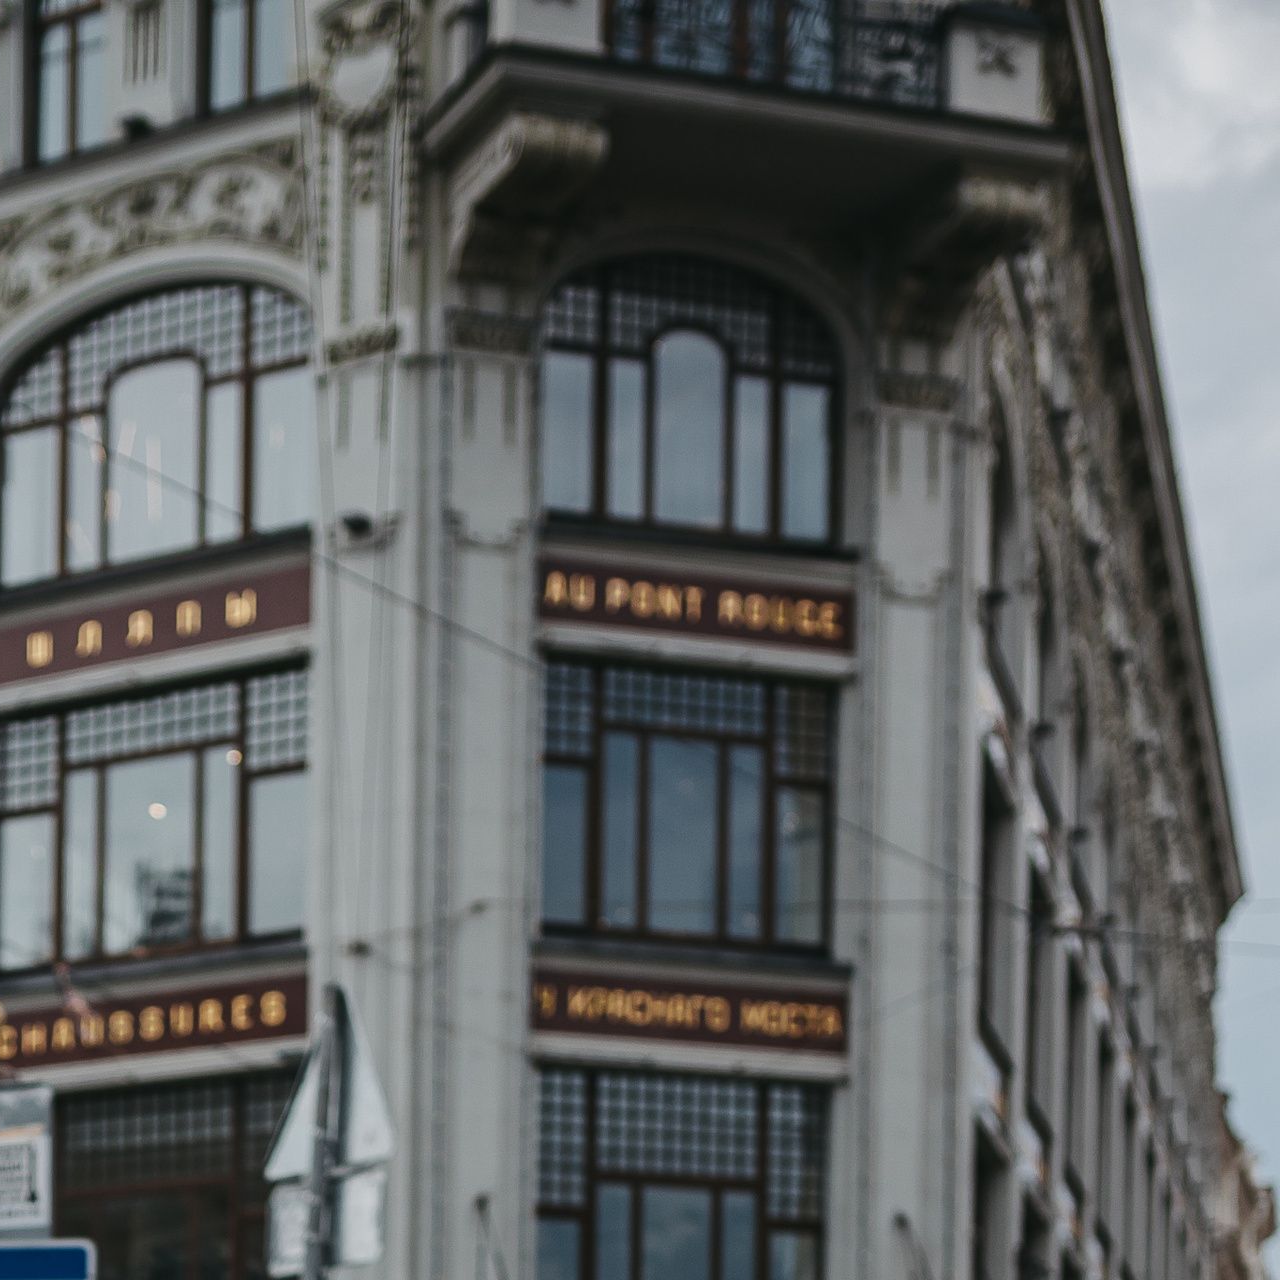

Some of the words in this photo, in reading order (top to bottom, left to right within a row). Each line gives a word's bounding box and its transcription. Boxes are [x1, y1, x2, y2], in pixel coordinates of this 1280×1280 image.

[25, 588, 257, 669] ШЛЯПЫ
[544, 570, 596, 612] AU
[605, 577, 704, 624] PONT
[718, 589, 844, 640] ROUGE
[567, 985, 732, 1033] КРАСНАГО
[739, 998, 845, 1038] МОСТА
